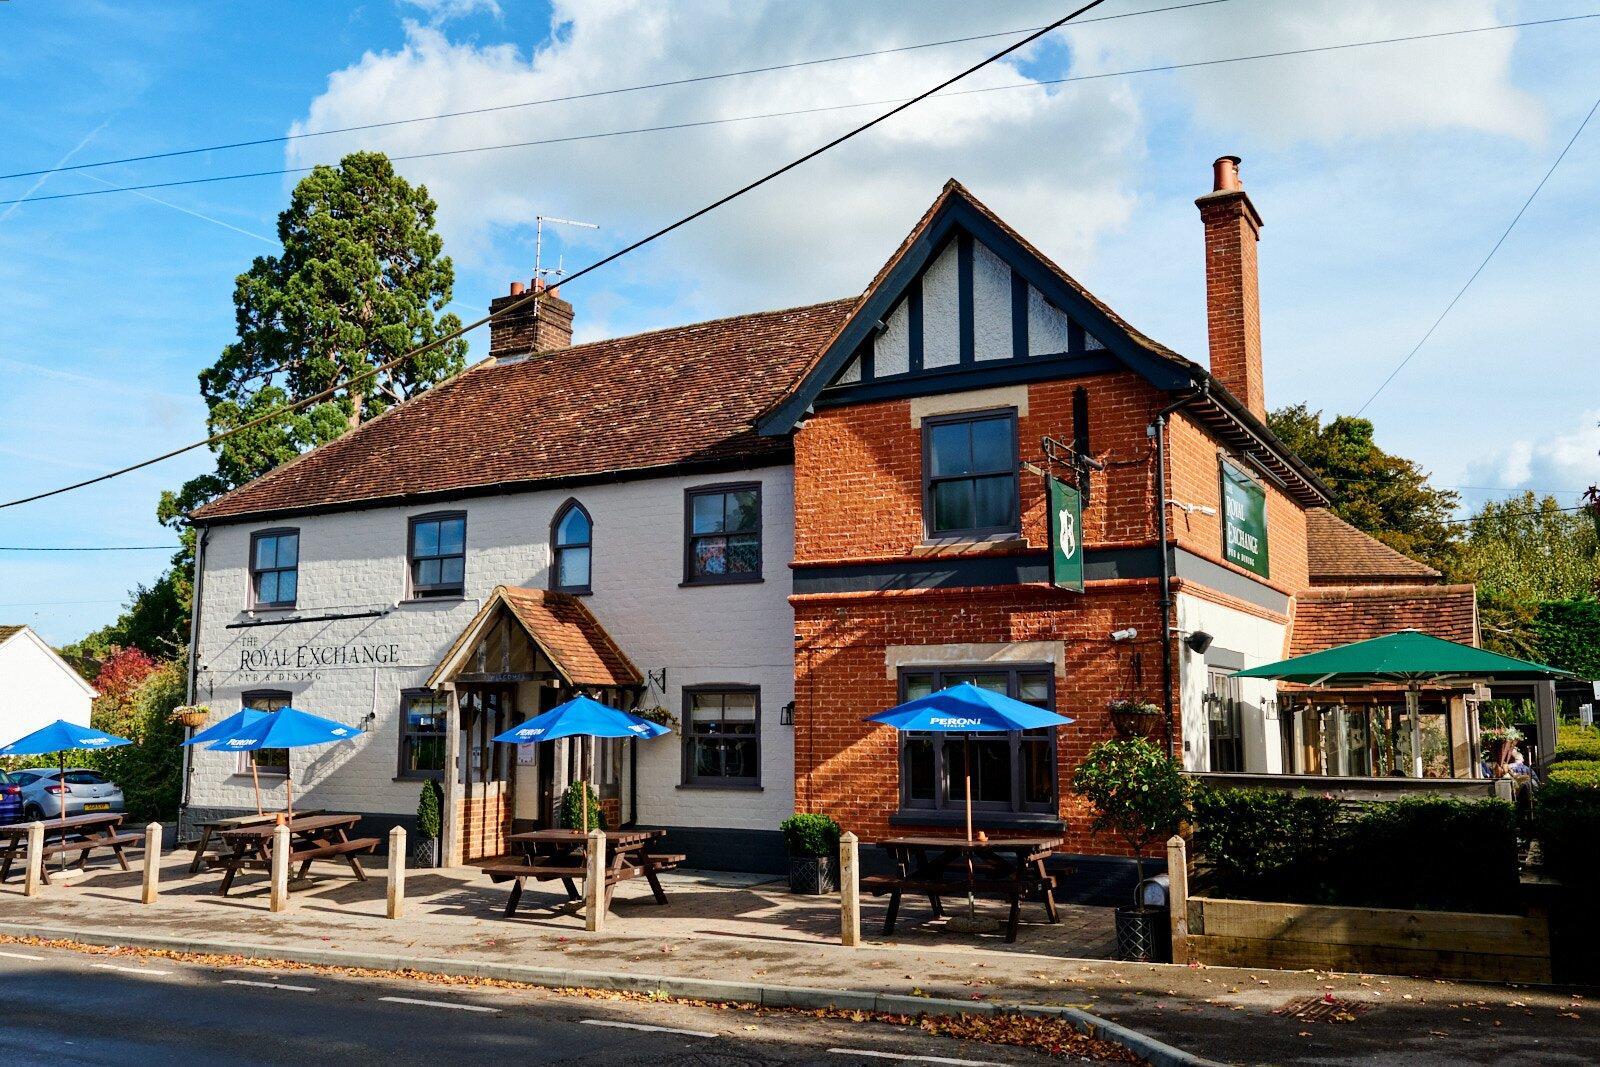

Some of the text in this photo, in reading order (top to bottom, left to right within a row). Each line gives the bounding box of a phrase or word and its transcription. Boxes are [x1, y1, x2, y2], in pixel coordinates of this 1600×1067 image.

[1226, 495, 1245, 521] ROYAL
[1227, 521, 1258, 555] EXCHANGE
[240, 637, 258, 647] THE
[240, 644, 400, 671] ROYAL EXCHANGE
[238, 673, 259, 682] PUB
[278, 672, 322, 682] DINING
